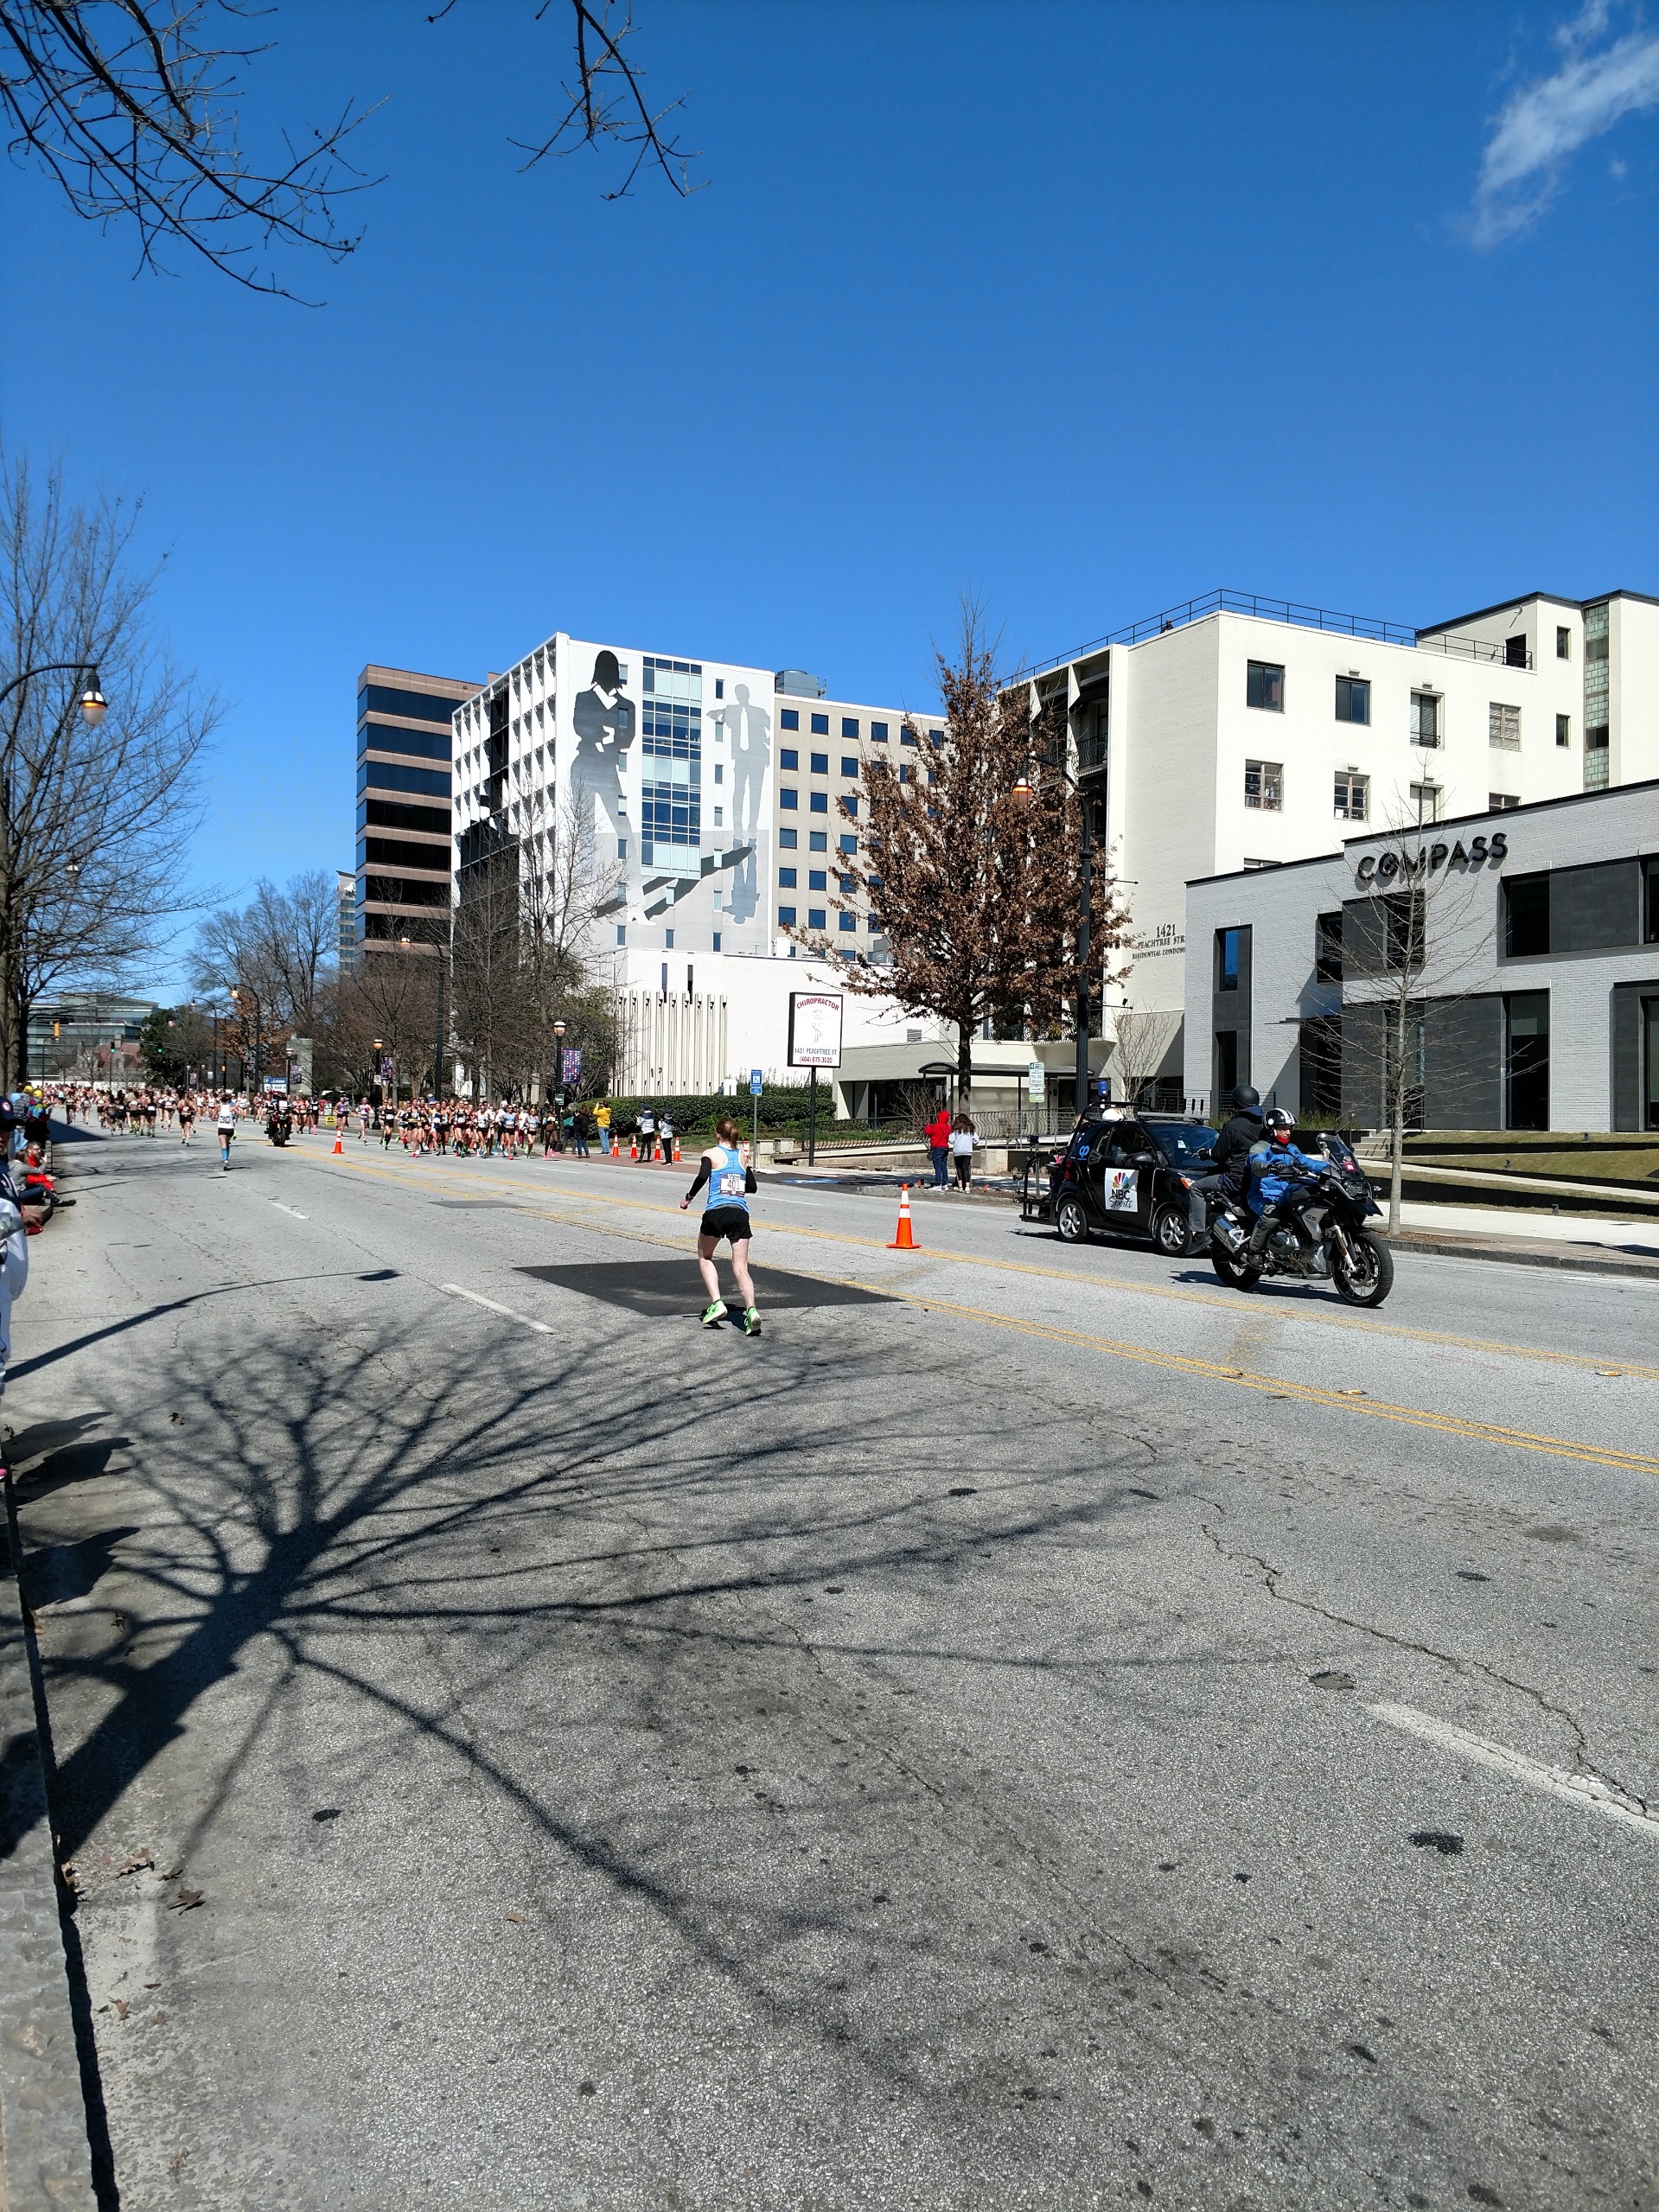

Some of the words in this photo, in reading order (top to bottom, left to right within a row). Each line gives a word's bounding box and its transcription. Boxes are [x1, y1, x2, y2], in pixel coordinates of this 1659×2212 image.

[1358, 832, 1509, 881] COMPASS
[1156, 923, 1176, 938] 1421
[1138, 937, 1171, 949] PEACHTREE
[796, 998, 839, 1011] CHIROPRACTOR
[1112, 1189, 1130, 1200] NBC
[1109, 1195, 1133, 1208] Sports
